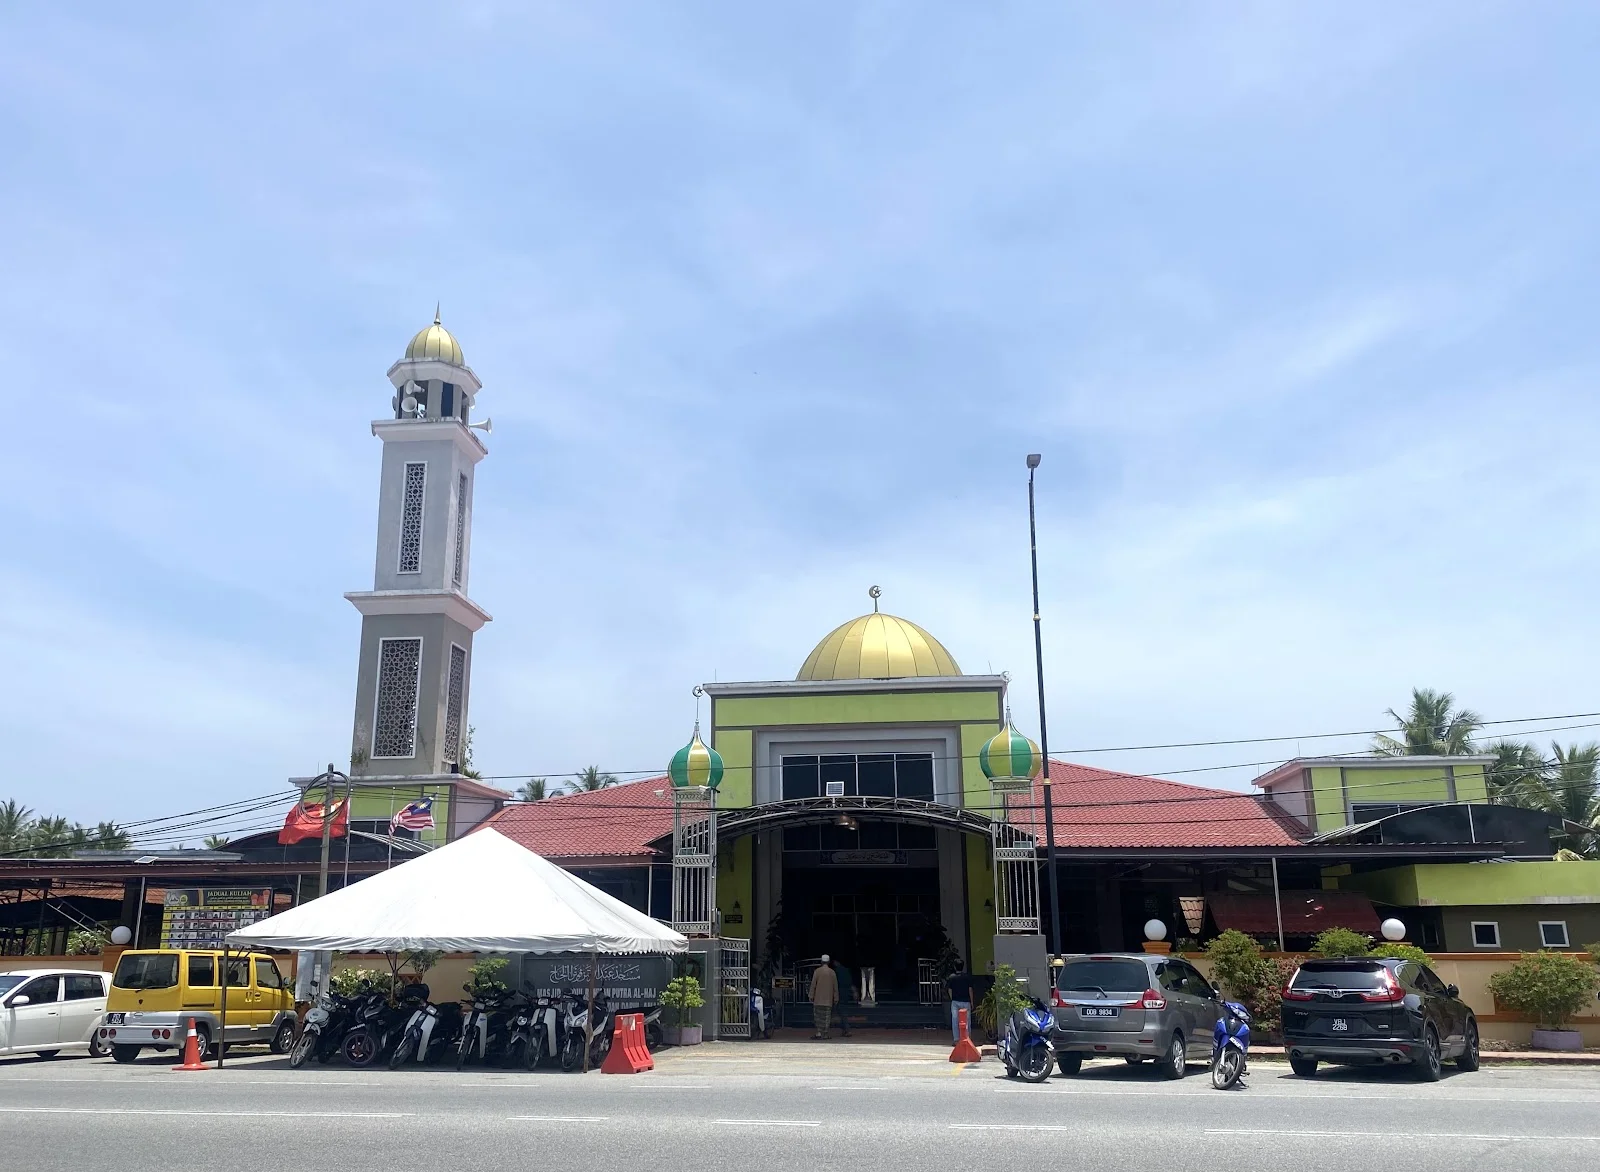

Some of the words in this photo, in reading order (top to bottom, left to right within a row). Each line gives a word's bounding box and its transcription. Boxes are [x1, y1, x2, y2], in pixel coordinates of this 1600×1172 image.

[536, 988, 561, 998] MASJID
[612, 988, 632, 999] PUTRA
[633, 988, 657, 998] AL-HAJ
